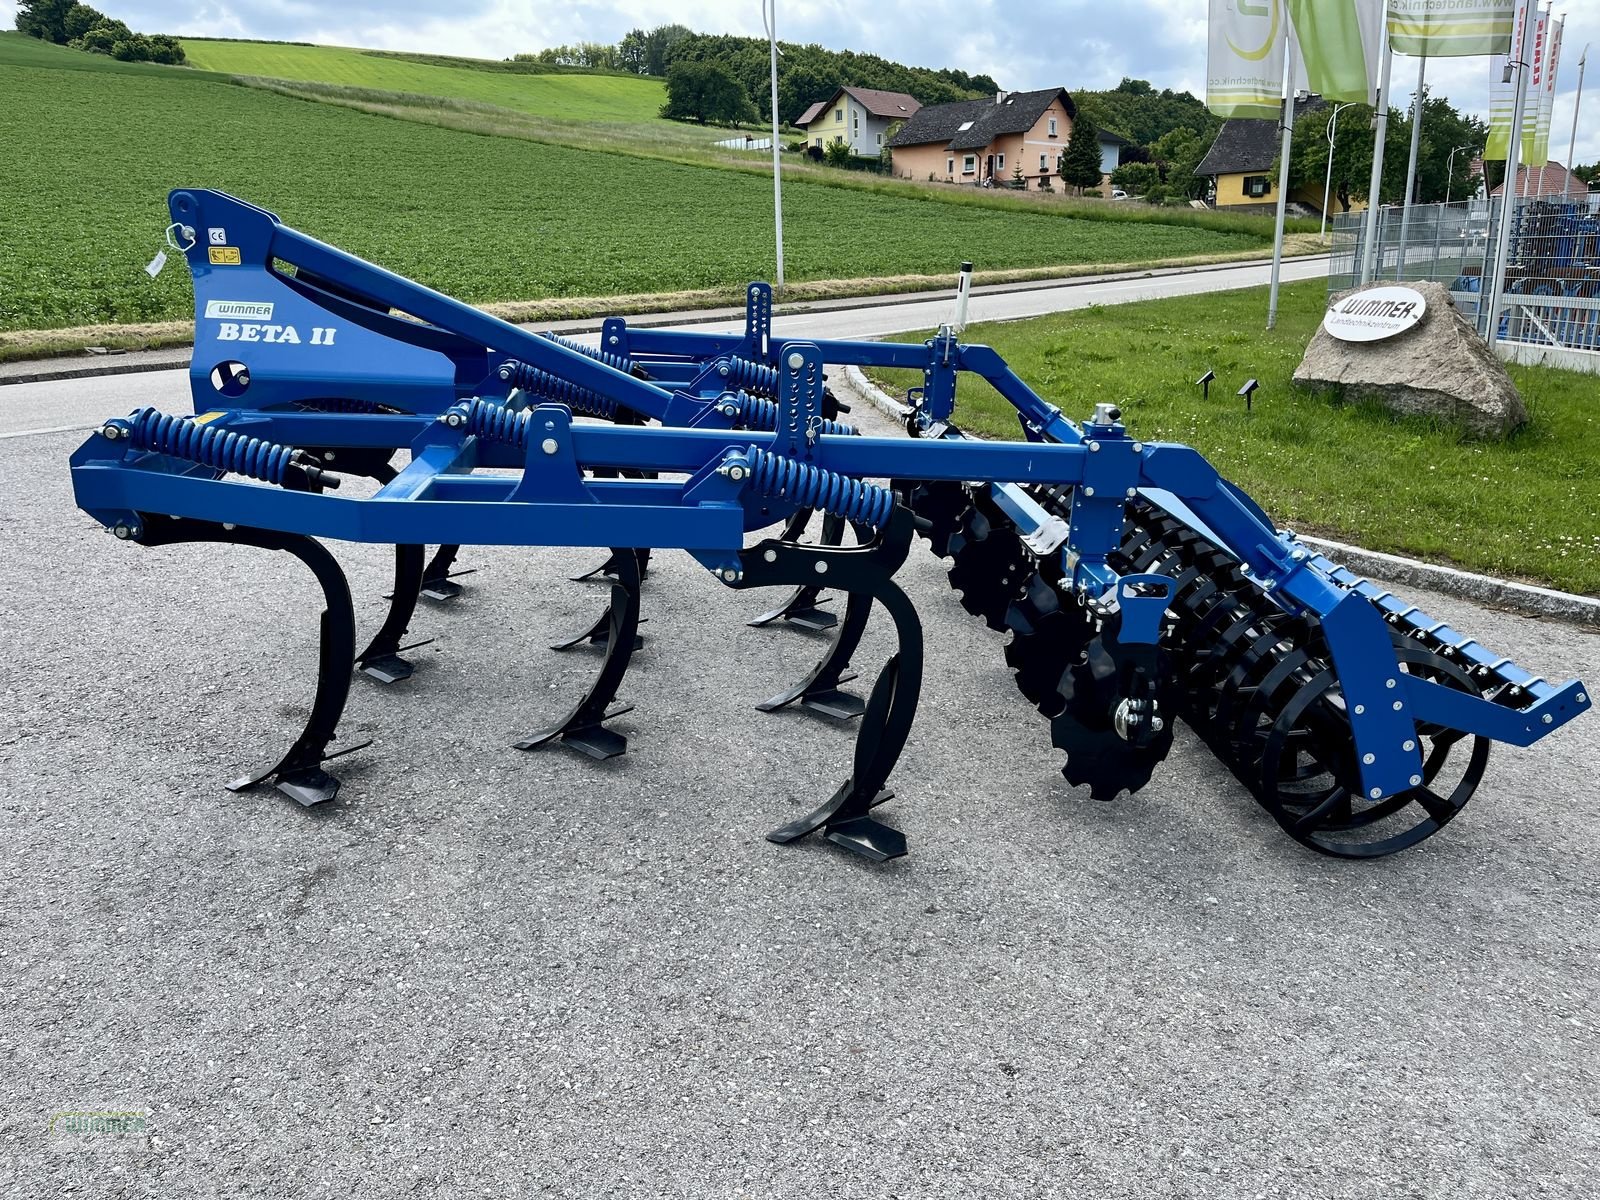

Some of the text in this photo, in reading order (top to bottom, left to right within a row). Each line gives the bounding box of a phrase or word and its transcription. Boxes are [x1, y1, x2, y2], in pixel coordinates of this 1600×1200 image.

[218, 304, 271, 315] WIMMER
[1340, 298, 1417, 319] WIMMER
[216, 322, 337, 346] BETA II
